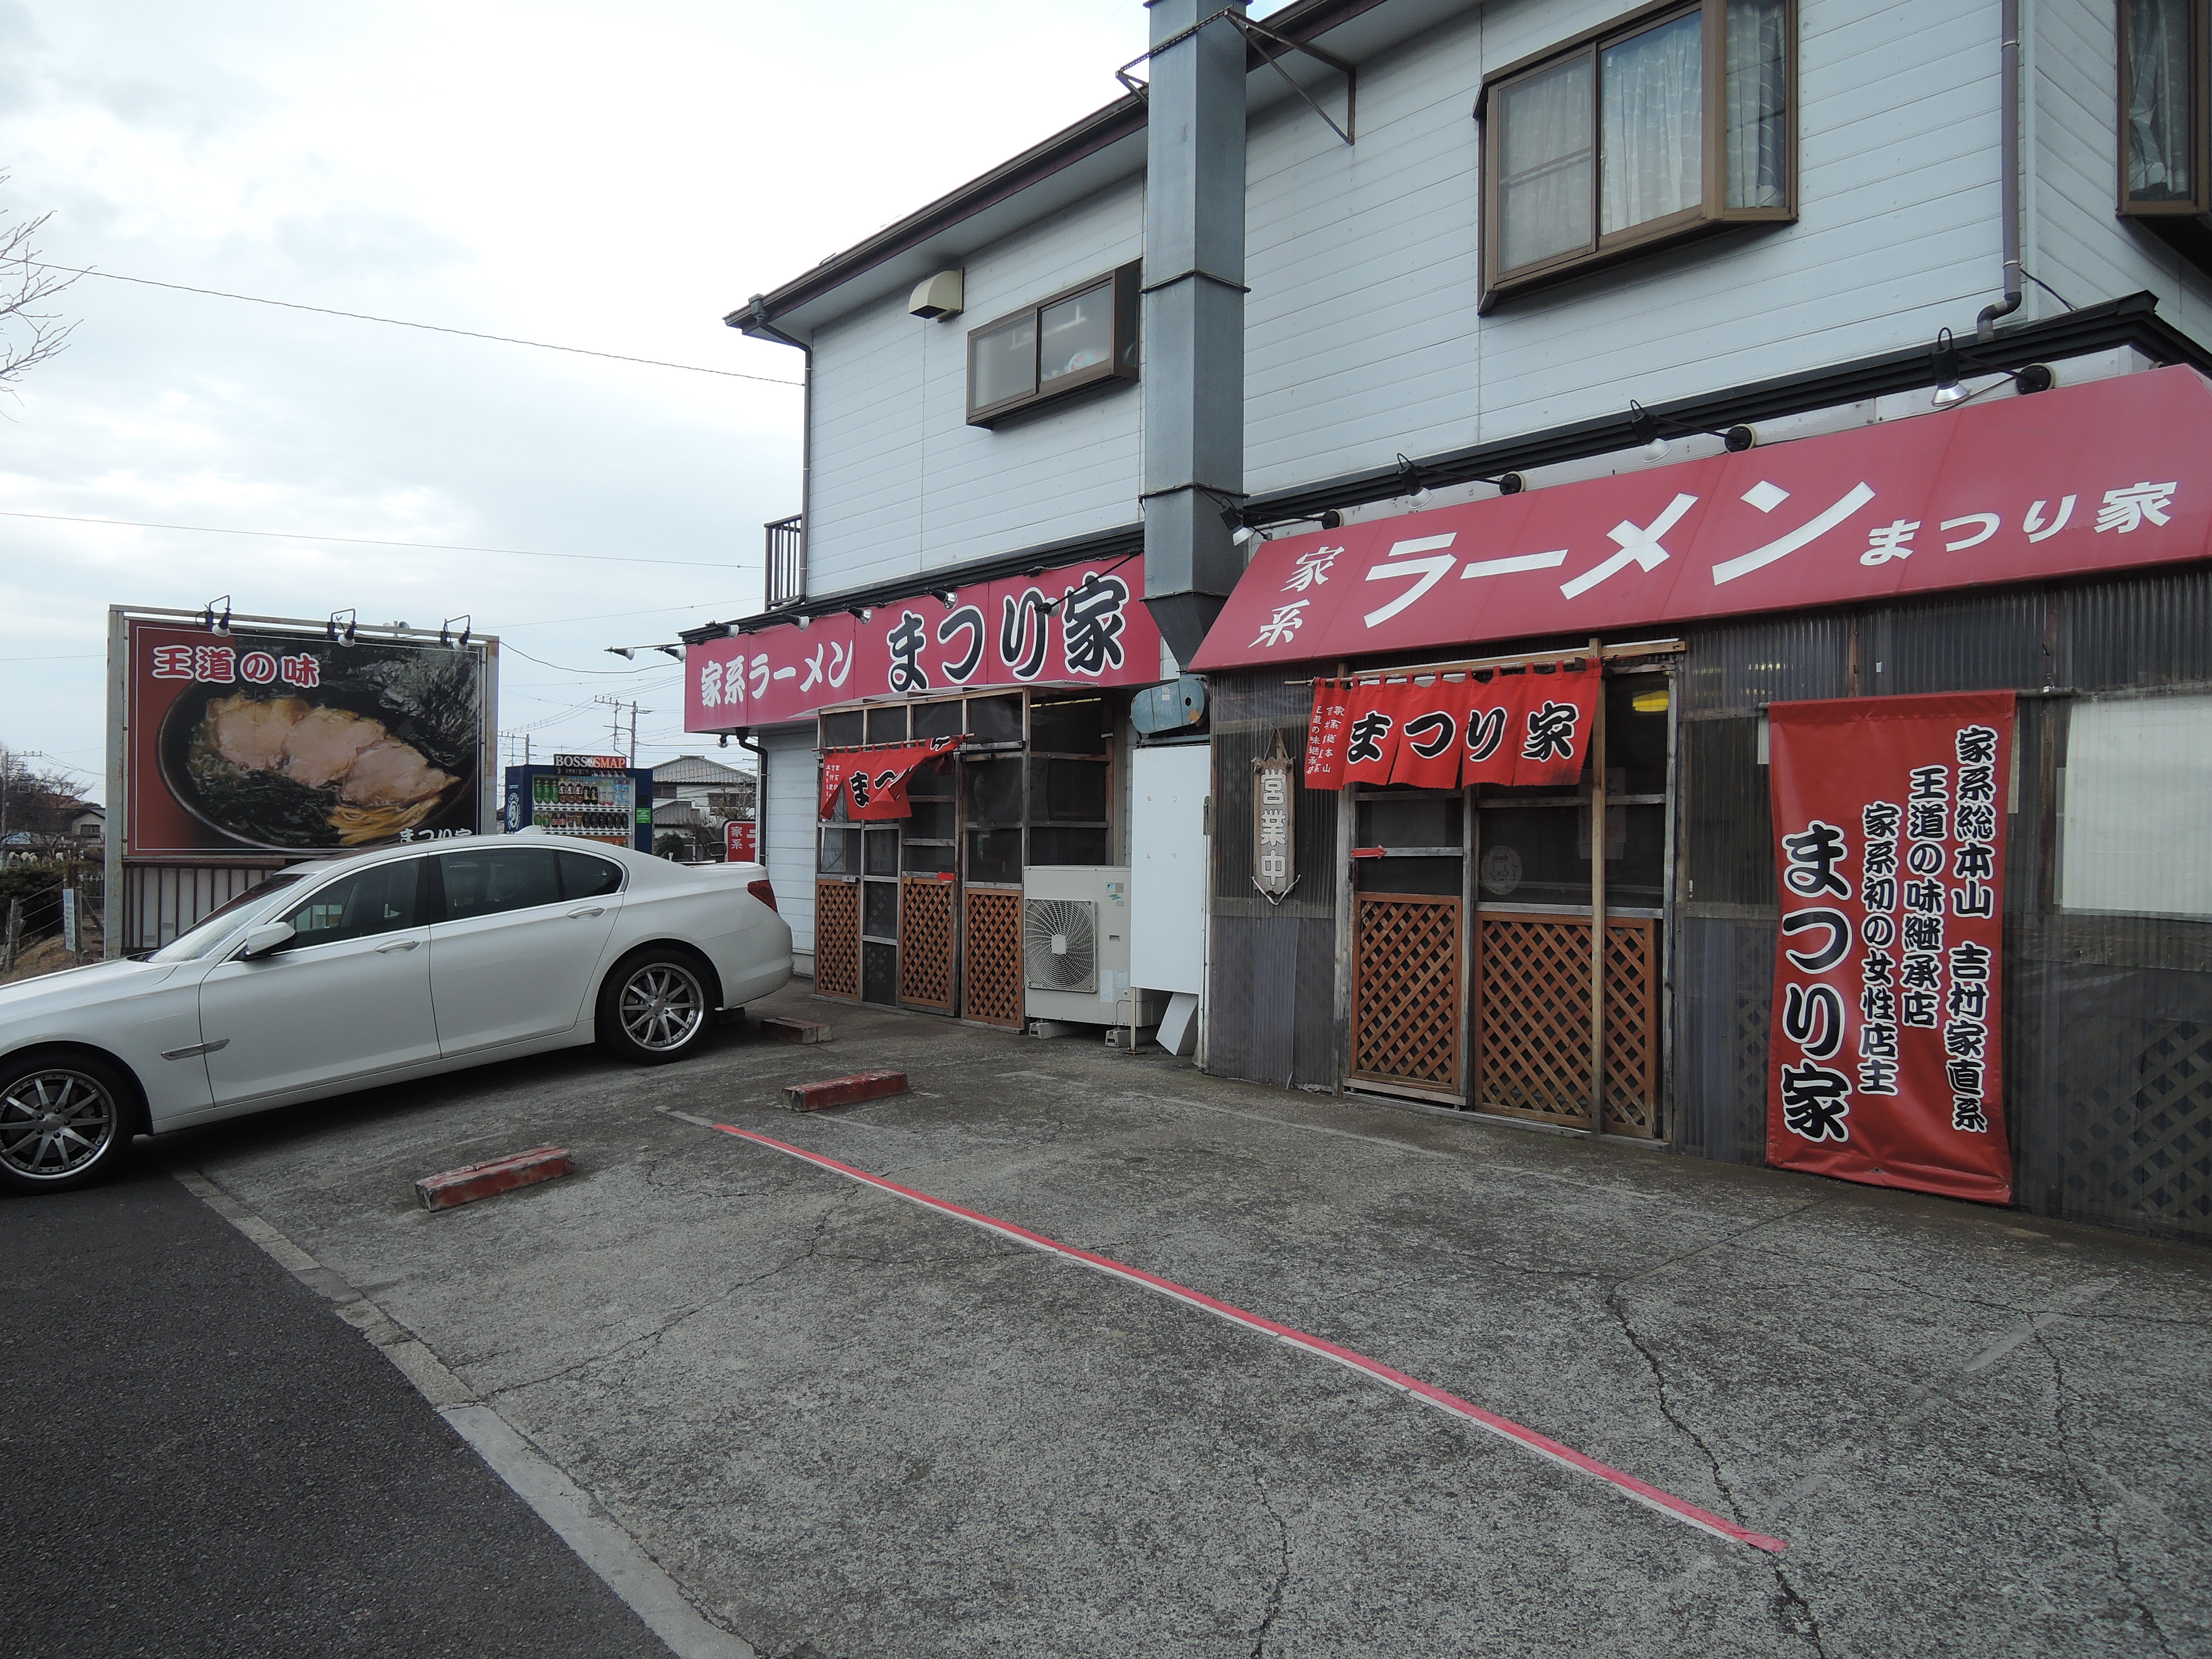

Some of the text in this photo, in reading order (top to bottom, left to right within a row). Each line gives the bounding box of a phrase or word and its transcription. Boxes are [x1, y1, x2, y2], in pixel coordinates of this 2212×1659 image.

[1248, 546, 1345, 648] 家系
[1364, 480, 2178, 628] ラーメン まつり家
[152, 644, 320, 688] 王道の味
[701, 571, 1130, 707] 家系ラーメン まつり家
[555, 755, 625, 769] BOSS SMAP
[1347, 700, 1579, 764] まつり家
[731, 826, 743, 849] 家系
[1260, 768, 1287, 886] 営業中
[1857, 801, 1901, 1095] 家系初の女性店主
[1901, 764, 1949, 1029] 王道の味継承店
[1945, 724, 1997, 1134] 家系総本山 吉村家直系
[1780, 820, 1853, 1143] まつり家
